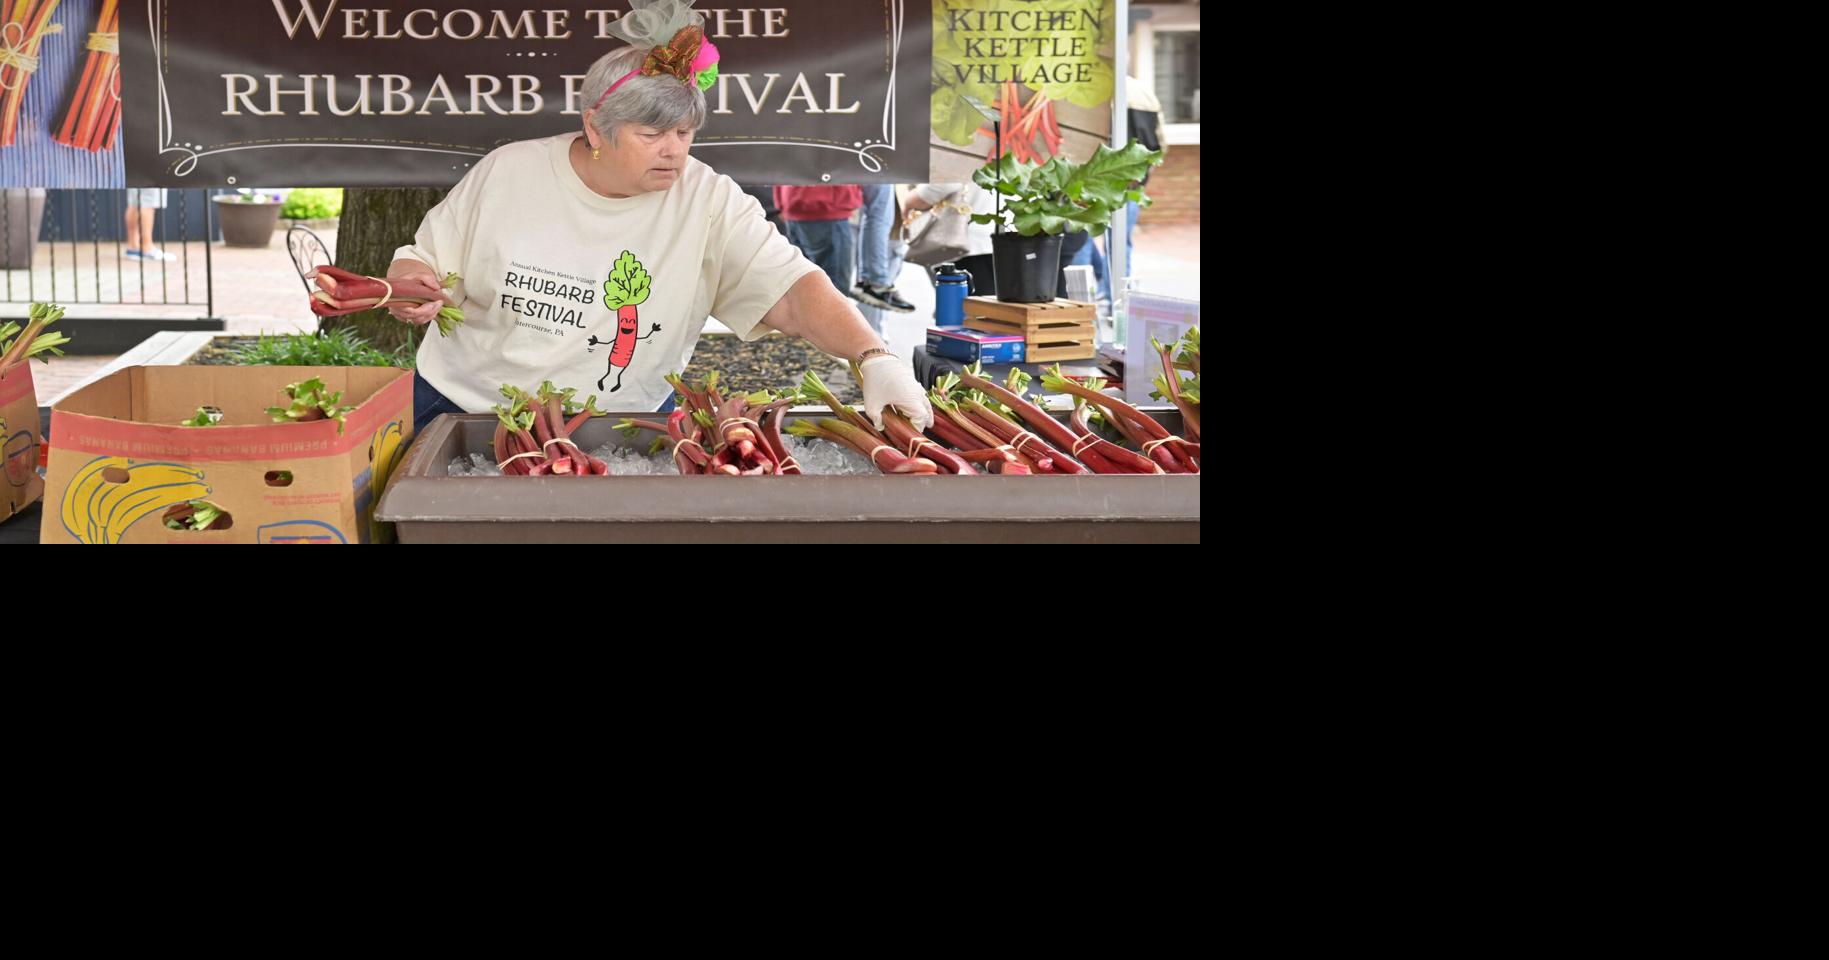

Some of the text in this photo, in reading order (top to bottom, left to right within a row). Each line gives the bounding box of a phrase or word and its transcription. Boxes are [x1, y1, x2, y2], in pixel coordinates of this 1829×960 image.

[271, 0, 573, 40] WELCOME
[584, 9, 661, 39] TO
[948, 8, 1103, 32] KITCHEN
[964, 37, 1087, 58] KETTLE
[952, 63, 1093, 84] VILLAGE
[220, 72, 861, 116] RHUBARB FIVAL
[510, 261, 597, 285] Annual Kitchen Kettle Village
[505, 271, 595, 304] RHUBARB
[501, 294, 587, 329] FESTIVAL
[554, 328, 564, 336] PA
[79, 435, 128, 451] BANANAS
[207, 443, 266, 455] BANANAS
[270, 439, 328, 454] PREMIUM
